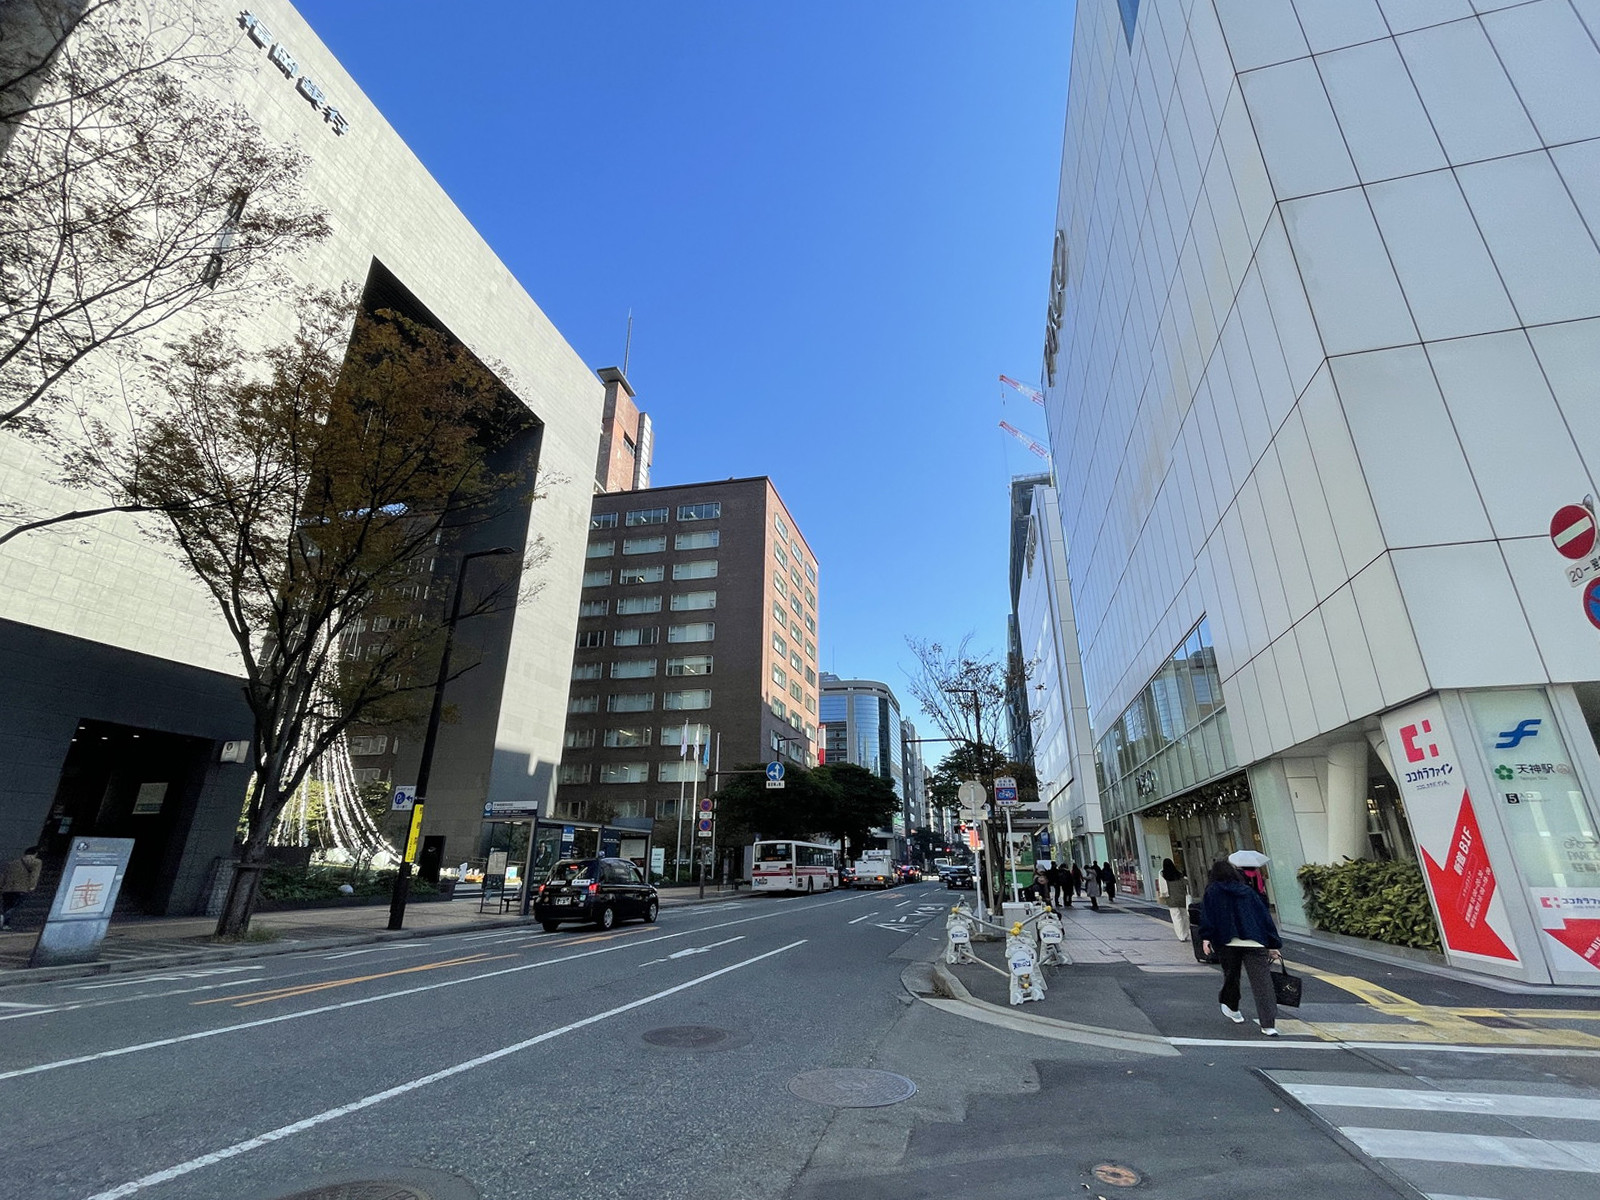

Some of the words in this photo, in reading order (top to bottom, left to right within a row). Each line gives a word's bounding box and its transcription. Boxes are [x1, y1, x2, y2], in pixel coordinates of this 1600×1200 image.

[236, 9, 350, 136] 福岡銀行
[1405, 763, 1453, 783] ココカラファイン
[1515, 763, 1556, 775] 天神駅
[1458, 826, 1472, 855] B1F
